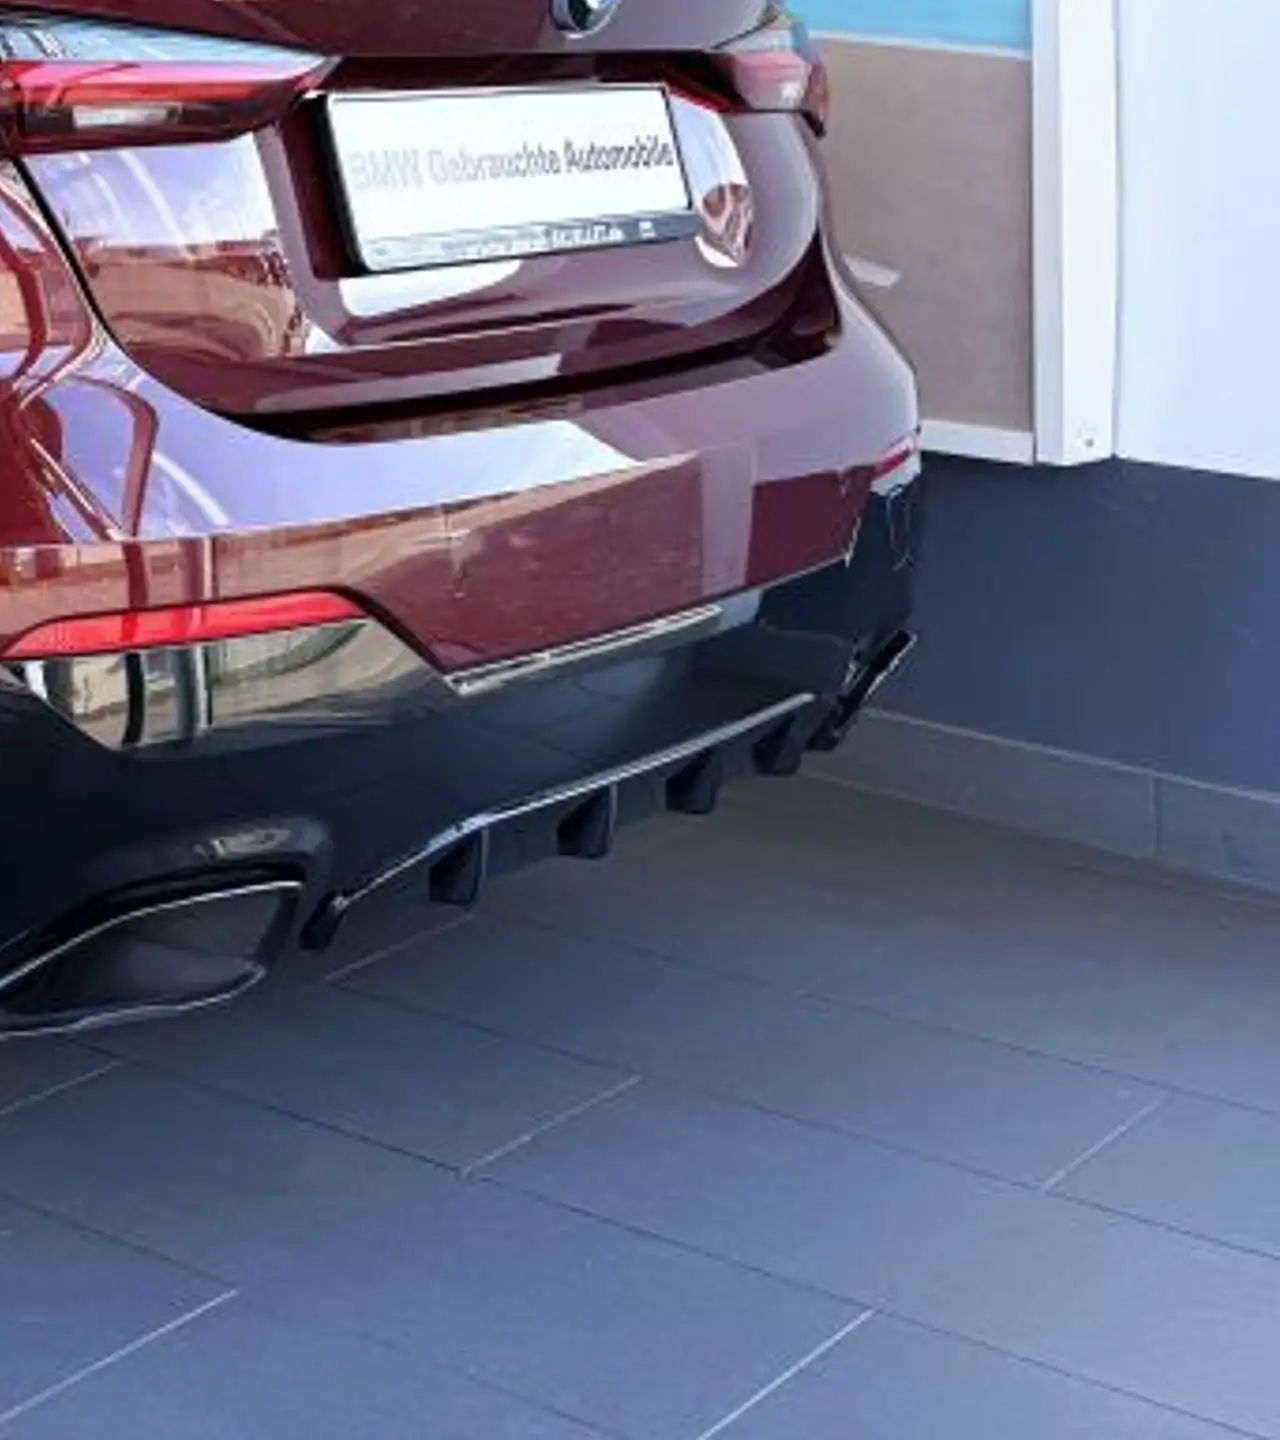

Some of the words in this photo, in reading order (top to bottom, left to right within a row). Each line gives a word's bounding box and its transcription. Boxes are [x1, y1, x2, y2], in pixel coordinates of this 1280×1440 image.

[350, 147, 423, 190] BMW
[428, 141, 561, 185] Gebrauchte
[564, 134, 675, 174] Automobile
